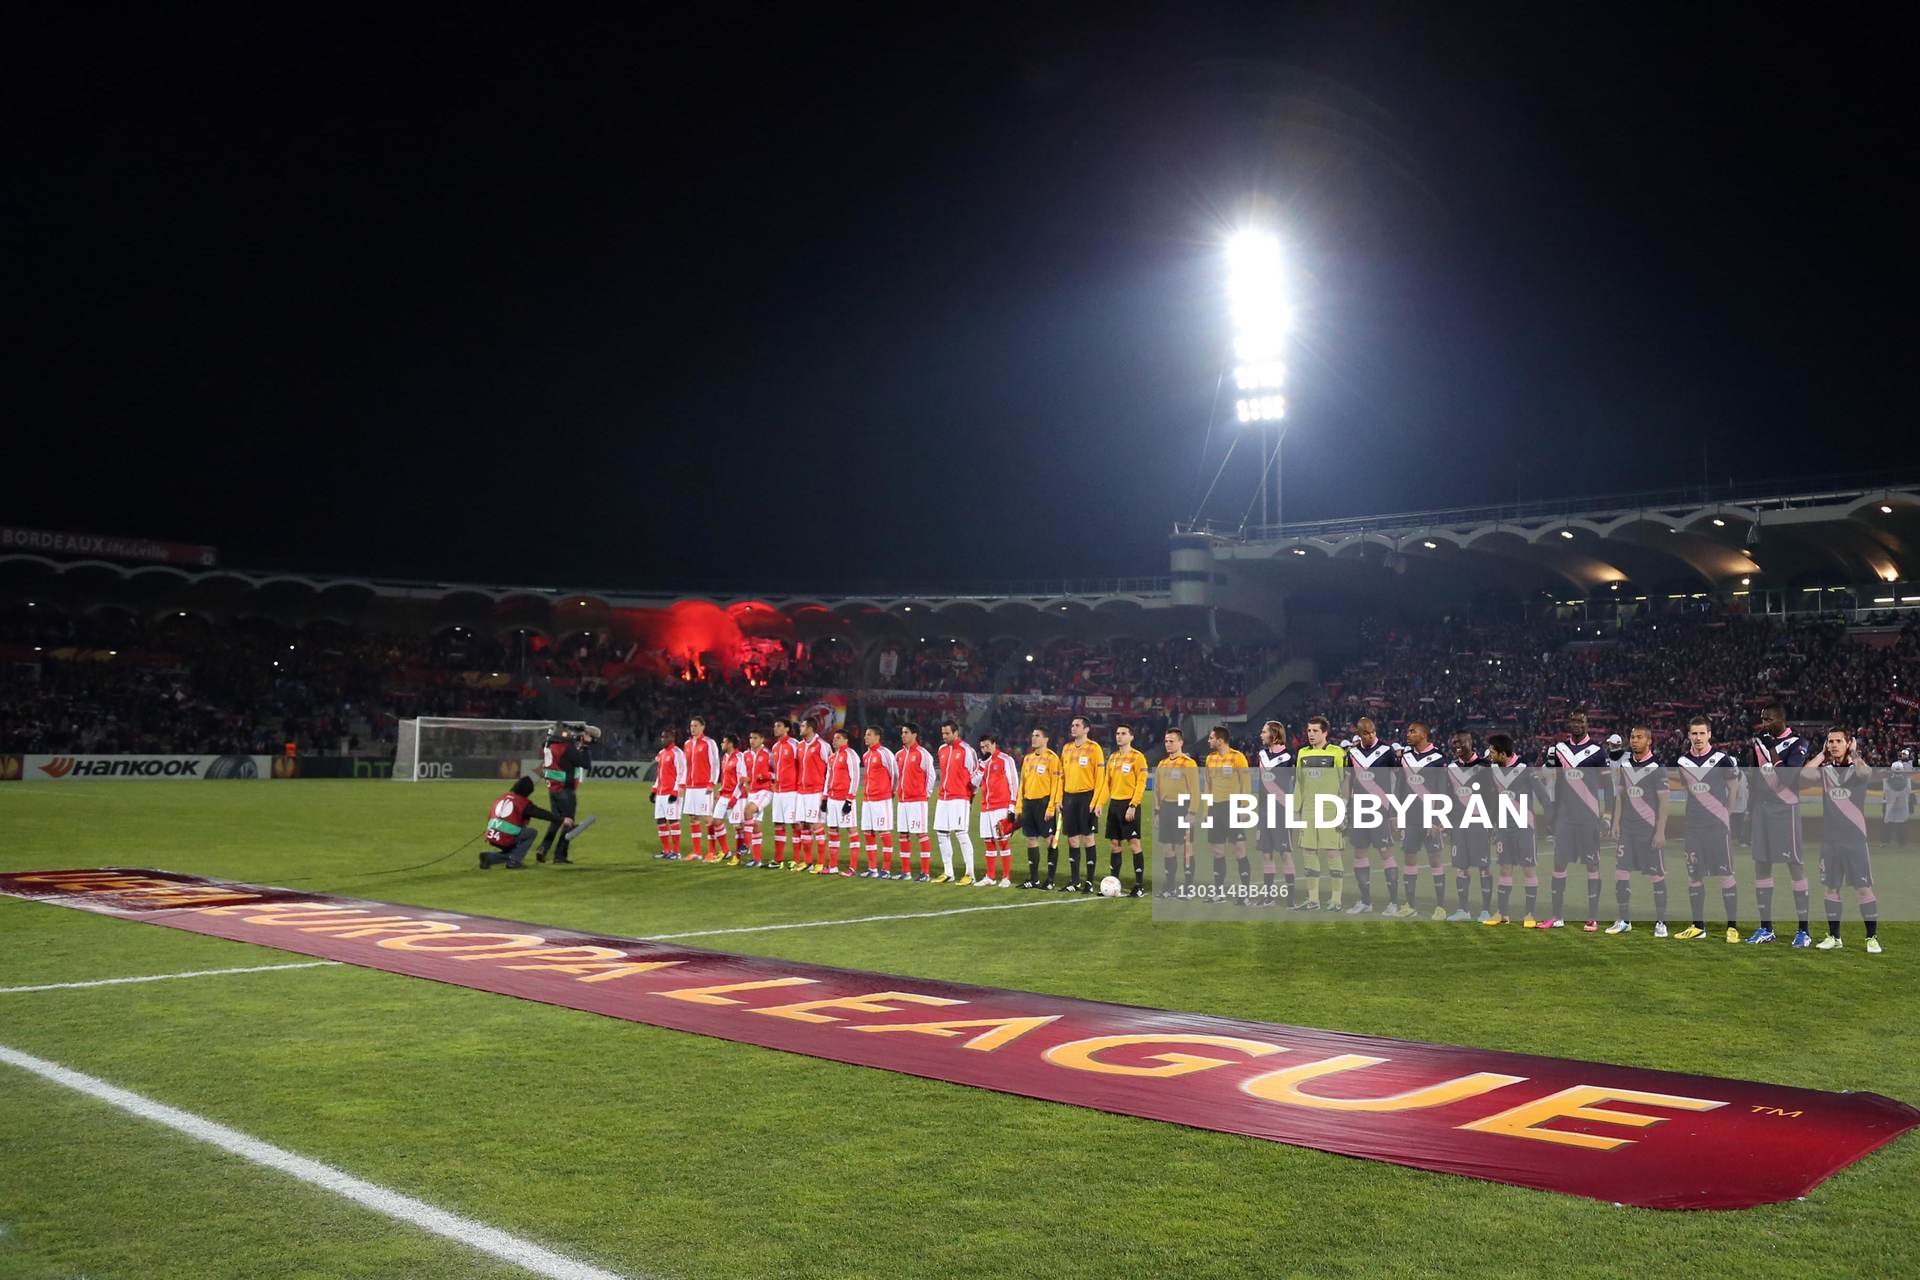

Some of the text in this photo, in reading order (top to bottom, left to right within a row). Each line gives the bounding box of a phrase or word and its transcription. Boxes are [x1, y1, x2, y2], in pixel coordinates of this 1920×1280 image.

[2, 530, 104, 553] BORDEAUX
[353, 756, 453, 778] ht one
[1831, 789, 1848, 797] KIA
[487, 829, 501, 842] 34
[1616, 843, 1626, 858] 5
[195, 902, 690, 983] EUROPA
[647, 976, 1732, 1152] LEAGUE
